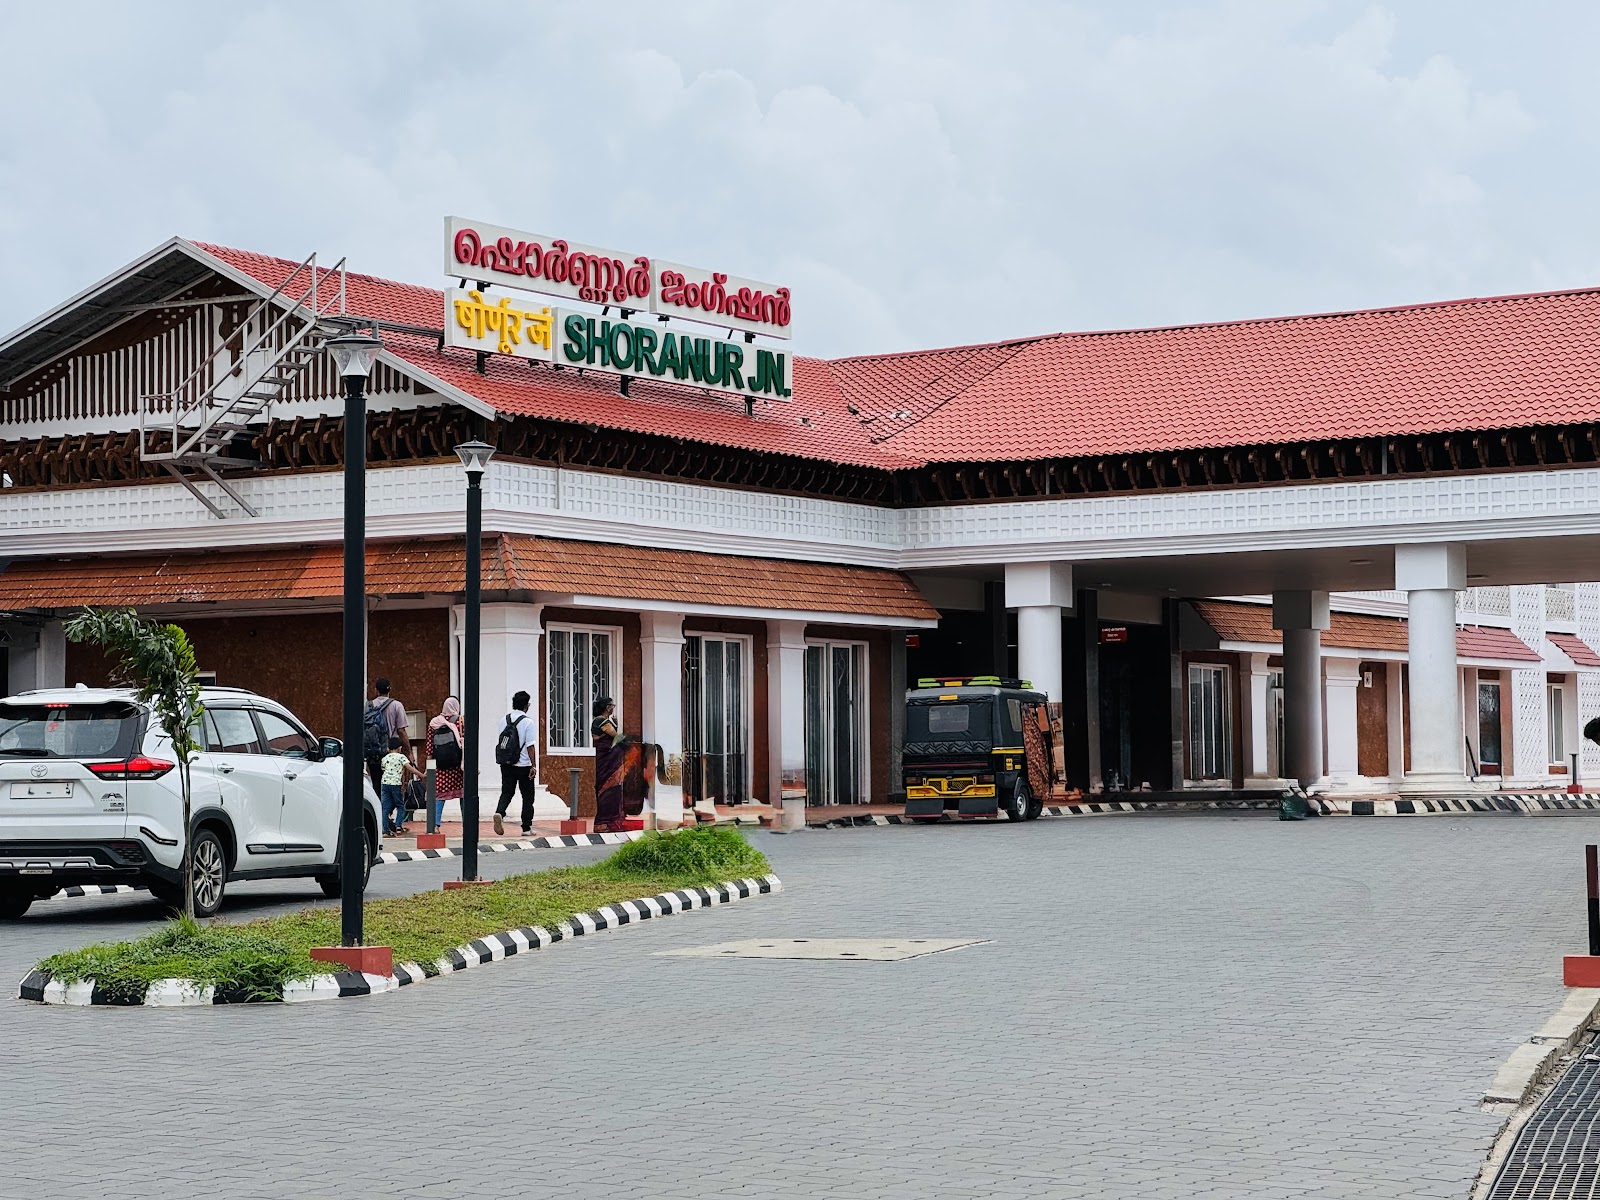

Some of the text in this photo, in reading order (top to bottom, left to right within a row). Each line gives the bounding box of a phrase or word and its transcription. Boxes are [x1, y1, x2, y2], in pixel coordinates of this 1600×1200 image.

[454, 289, 524, 355] षोर्णूर
[661, 270, 791, 327] ജംഗ്ഷൻ
[563, 314, 791, 397] SHORANUR JN.
